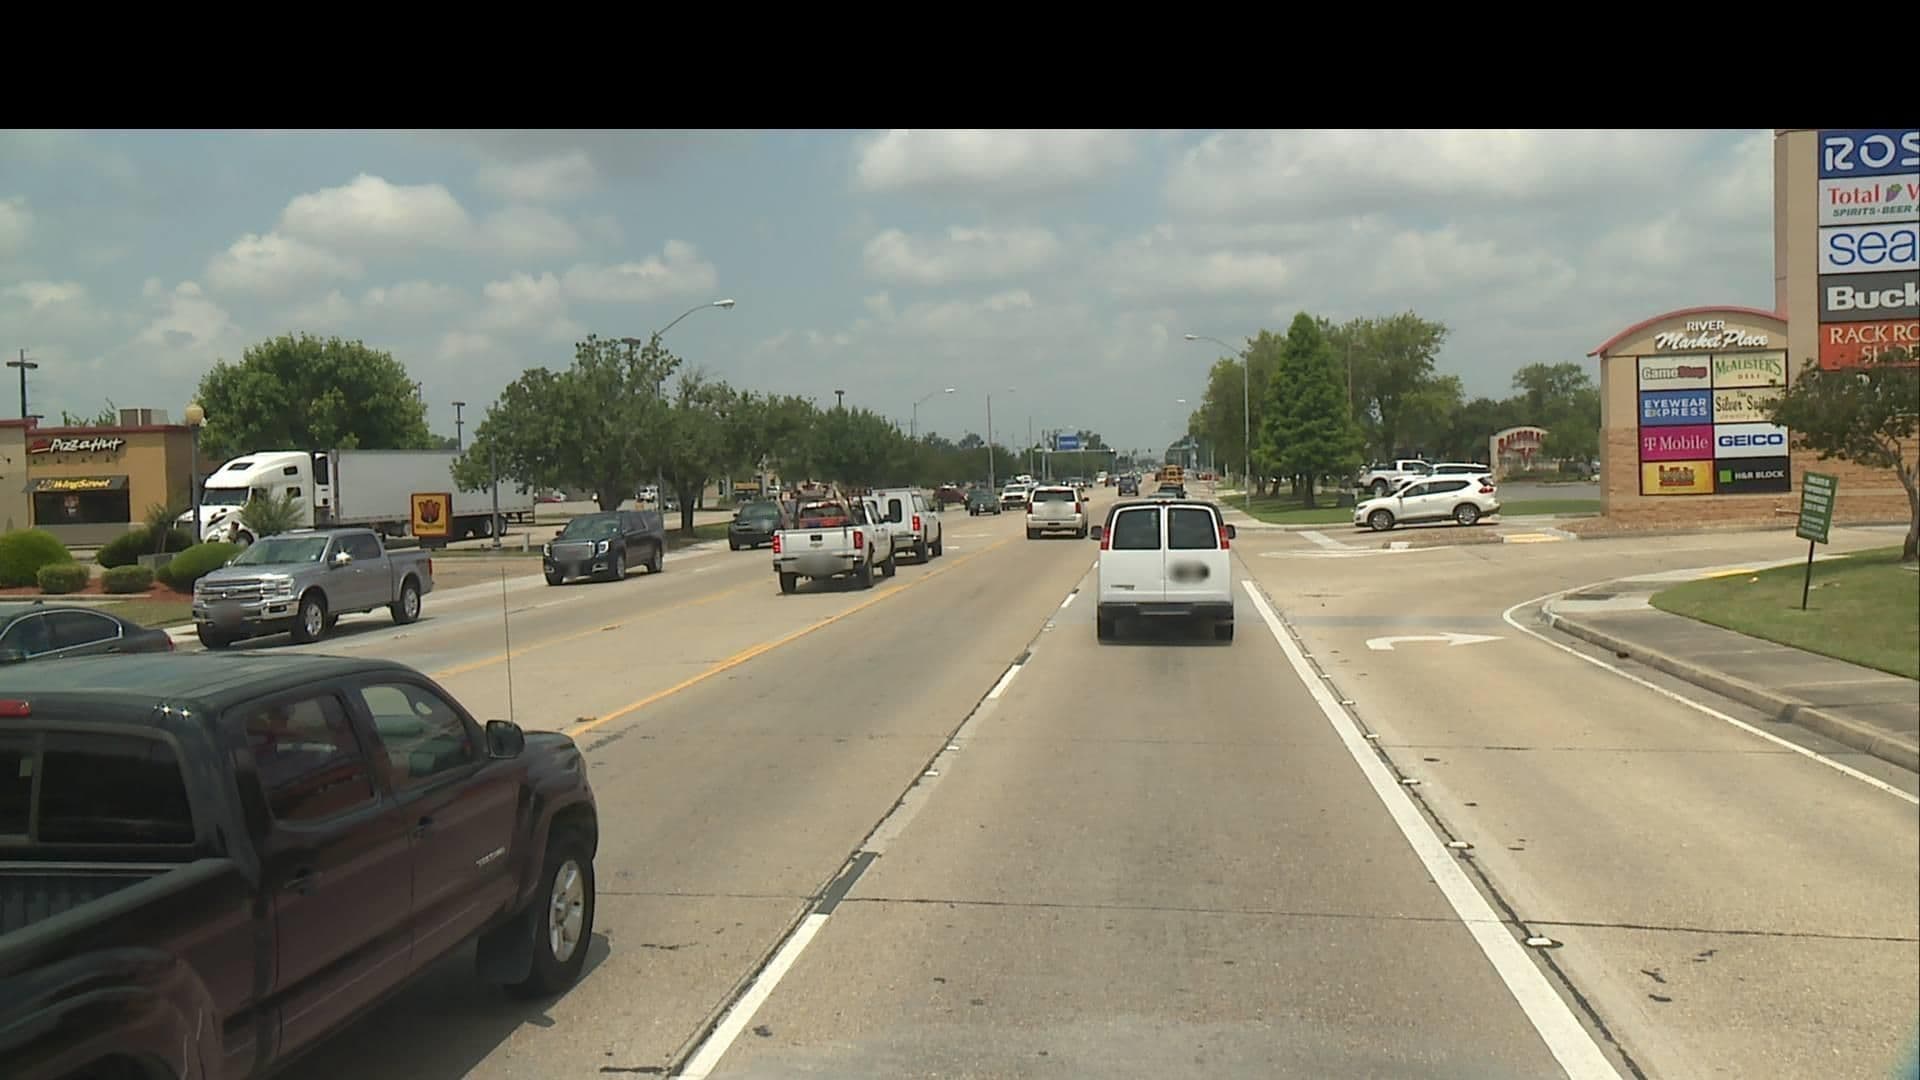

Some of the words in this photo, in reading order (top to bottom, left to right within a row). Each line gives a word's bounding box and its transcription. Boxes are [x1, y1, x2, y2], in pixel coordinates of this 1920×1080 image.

[1827, 184, 1879, 205] Total
[1686, 320, 1726, 331] RIVER
[1830, 325, 1889, 345] RACK
[1644, 398, 1706, 409] EYEWEAR
[1644, 407, 1708, 418] EXPRESS
[1660, 435, 1709, 450] Mobile
[1718, 433, 1784, 447] GEICO
[1735, 471, 1753, 480] H&R
[1755, 470, 1785, 480] BLOCK
